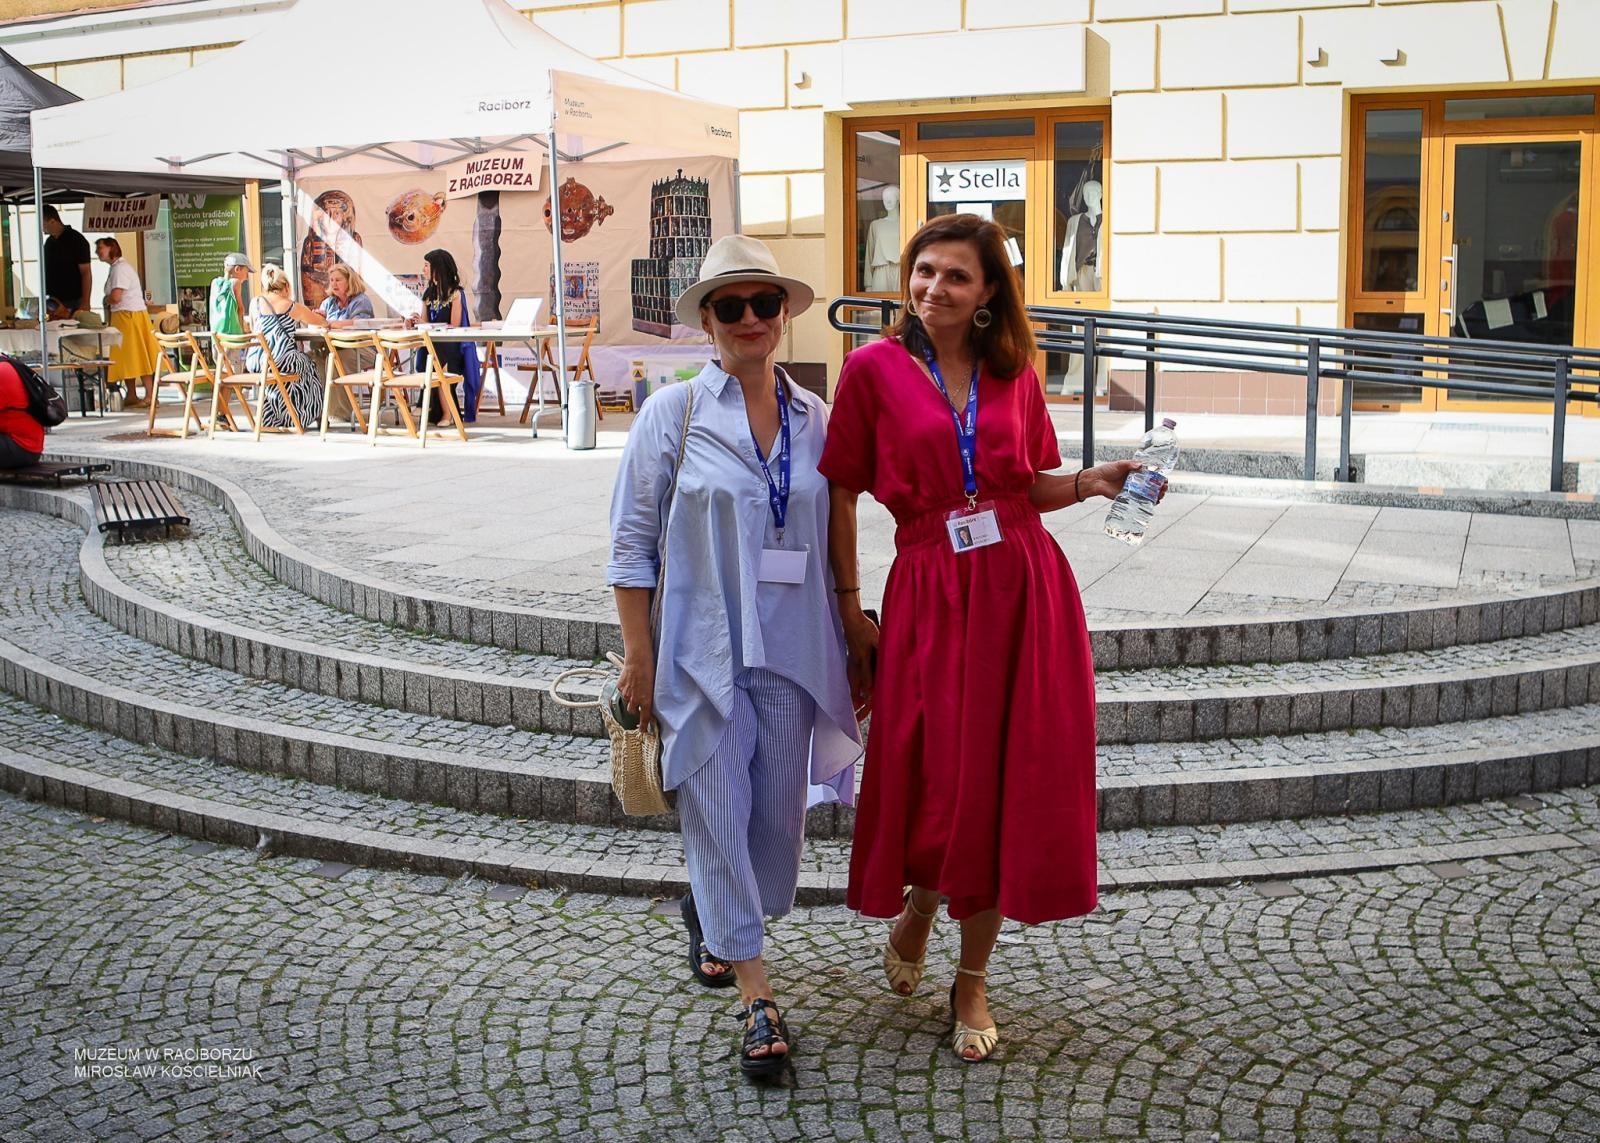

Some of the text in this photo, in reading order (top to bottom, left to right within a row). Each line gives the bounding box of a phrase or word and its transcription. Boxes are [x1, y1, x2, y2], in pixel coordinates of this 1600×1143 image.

[466, 157, 524, 175] MUZEUM
[449, 173, 533, 192] Z RACIBORZA
[958, 168, 1020, 189] Stella
[103, 199, 146, 212] MUZEUM
[88, 214, 153, 229] NOVOJIČÍNSKA
[209, 218, 229, 227] Příbor
